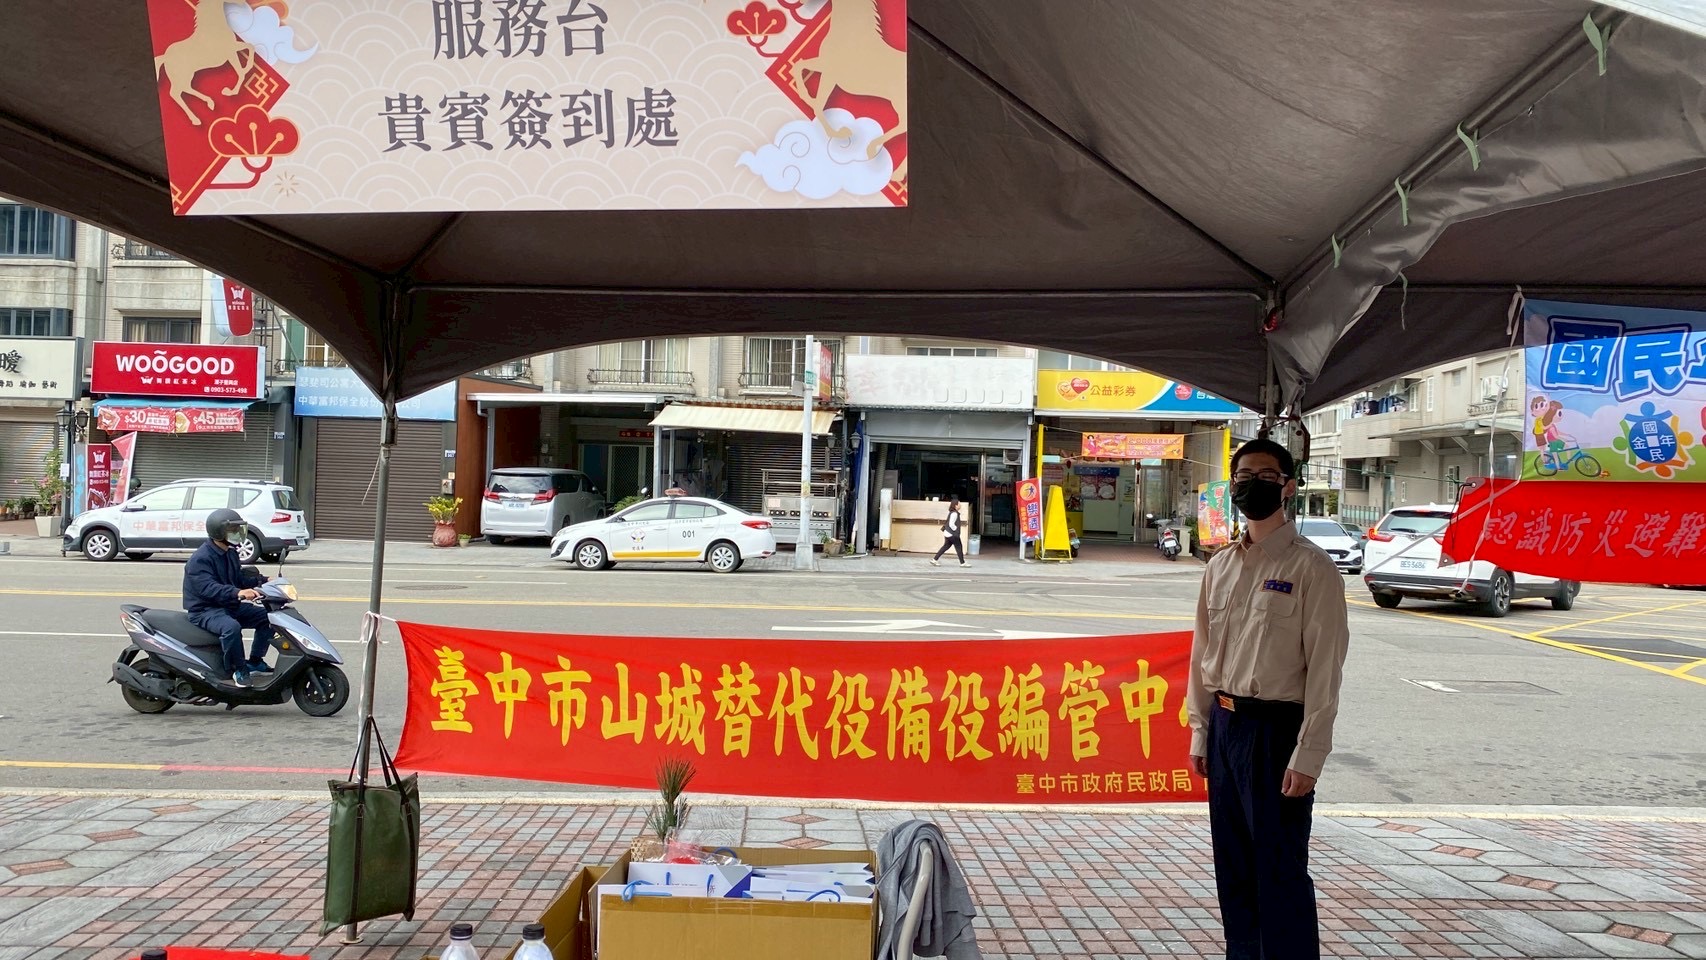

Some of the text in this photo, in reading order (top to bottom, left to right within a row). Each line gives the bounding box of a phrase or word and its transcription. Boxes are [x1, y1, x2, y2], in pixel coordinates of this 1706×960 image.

[433, 0, 610, 60] 服務台
[377, 86, 681, 153] 貴賓簽到處
[0, 349, 22, 374] 暖
[1542, 315, 1706, 402] 國民
[42, 380, 58, 389] 藝術
[1090, 385, 1136, 397] 公益彩券
[125, 410, 146, 423] $30
[193, 410, 216, 425] $45
[1631, 436, 1647, 450] 金
[1659, 434, 1675, 447] 年
[1649, 448, 1665, 462] 民
[682, 530, 695, 538] 001
[1481, 507, 1706, 558] 認識防災避難
[430, 647, 1189, 763] 臺中市山城替代役備役編管中
[1016, 769, 1192, 794] 臺中市政府民政局
